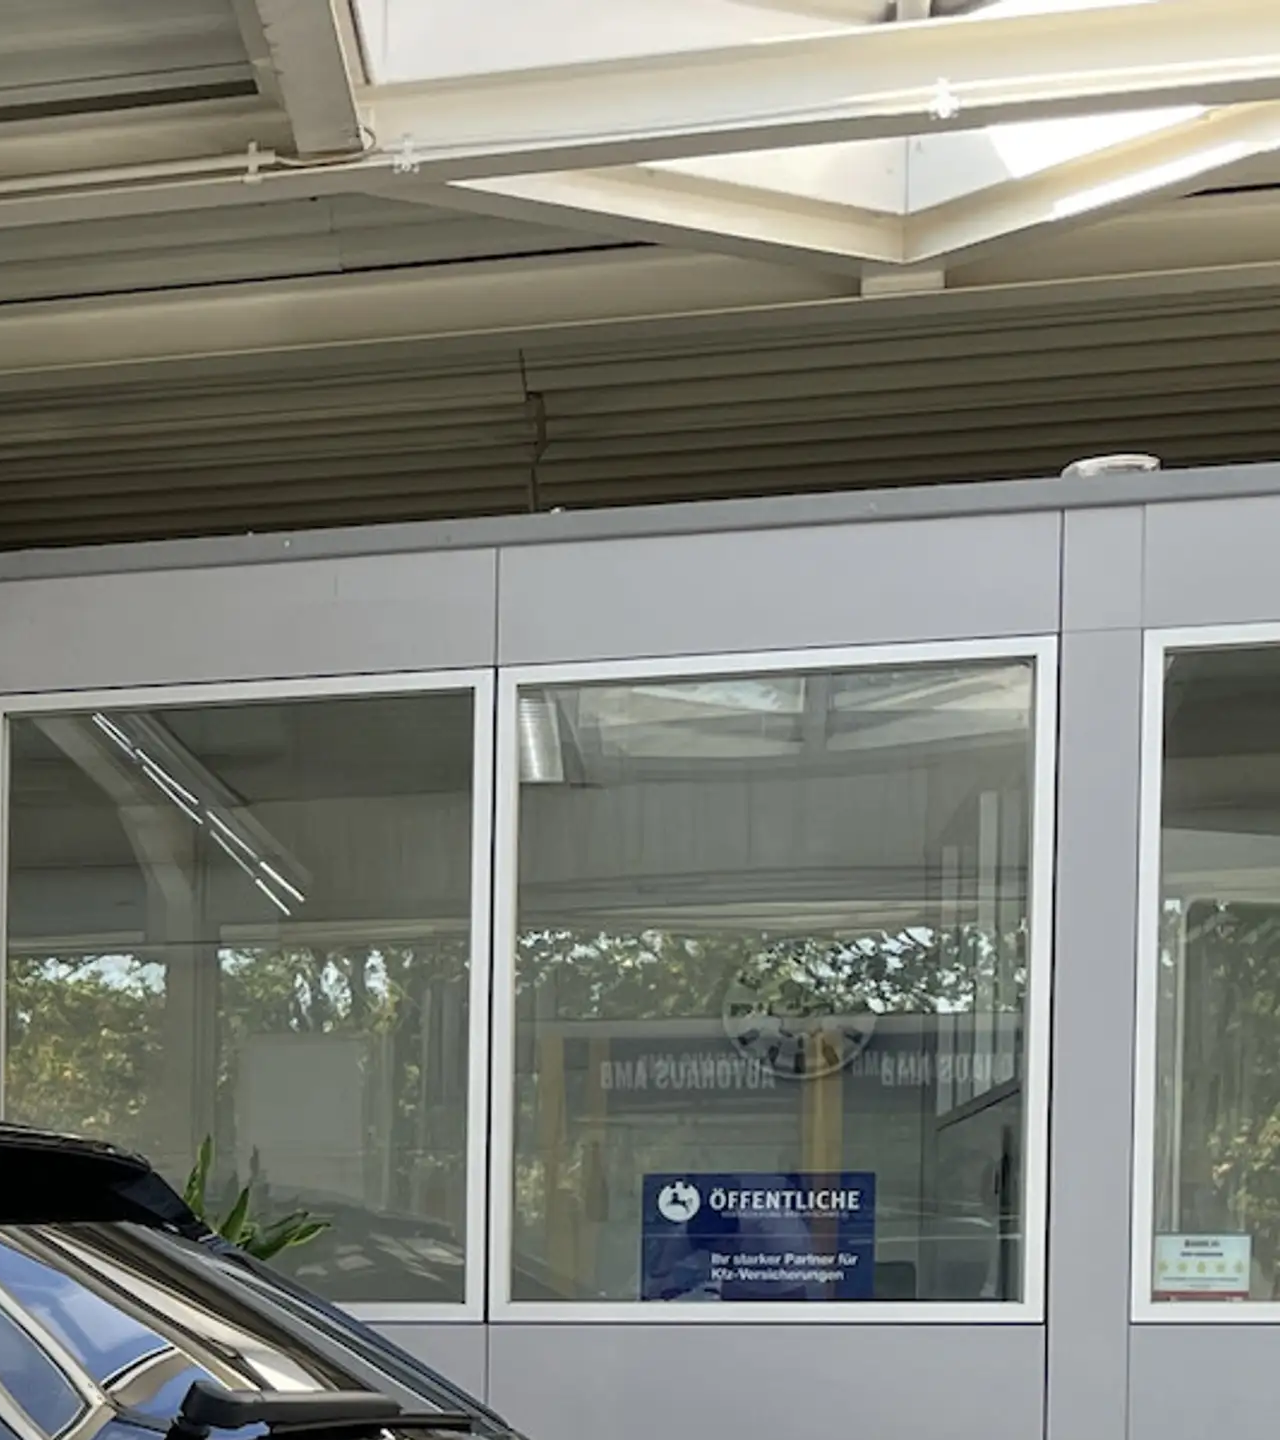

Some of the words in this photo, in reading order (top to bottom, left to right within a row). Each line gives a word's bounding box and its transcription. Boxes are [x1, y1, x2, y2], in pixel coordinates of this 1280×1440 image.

[709, 1188, 860, 1210] ÖFFENTLICHE
[711, 1253, 730, 1265] Ihr
[733, 1253, 782, 1265] starker
[784, 1253, 834, 1265] Partner
[838, 1252, 859, 1265] für
[711, 1269, 844, 1283] Kfz-Versicherungen
